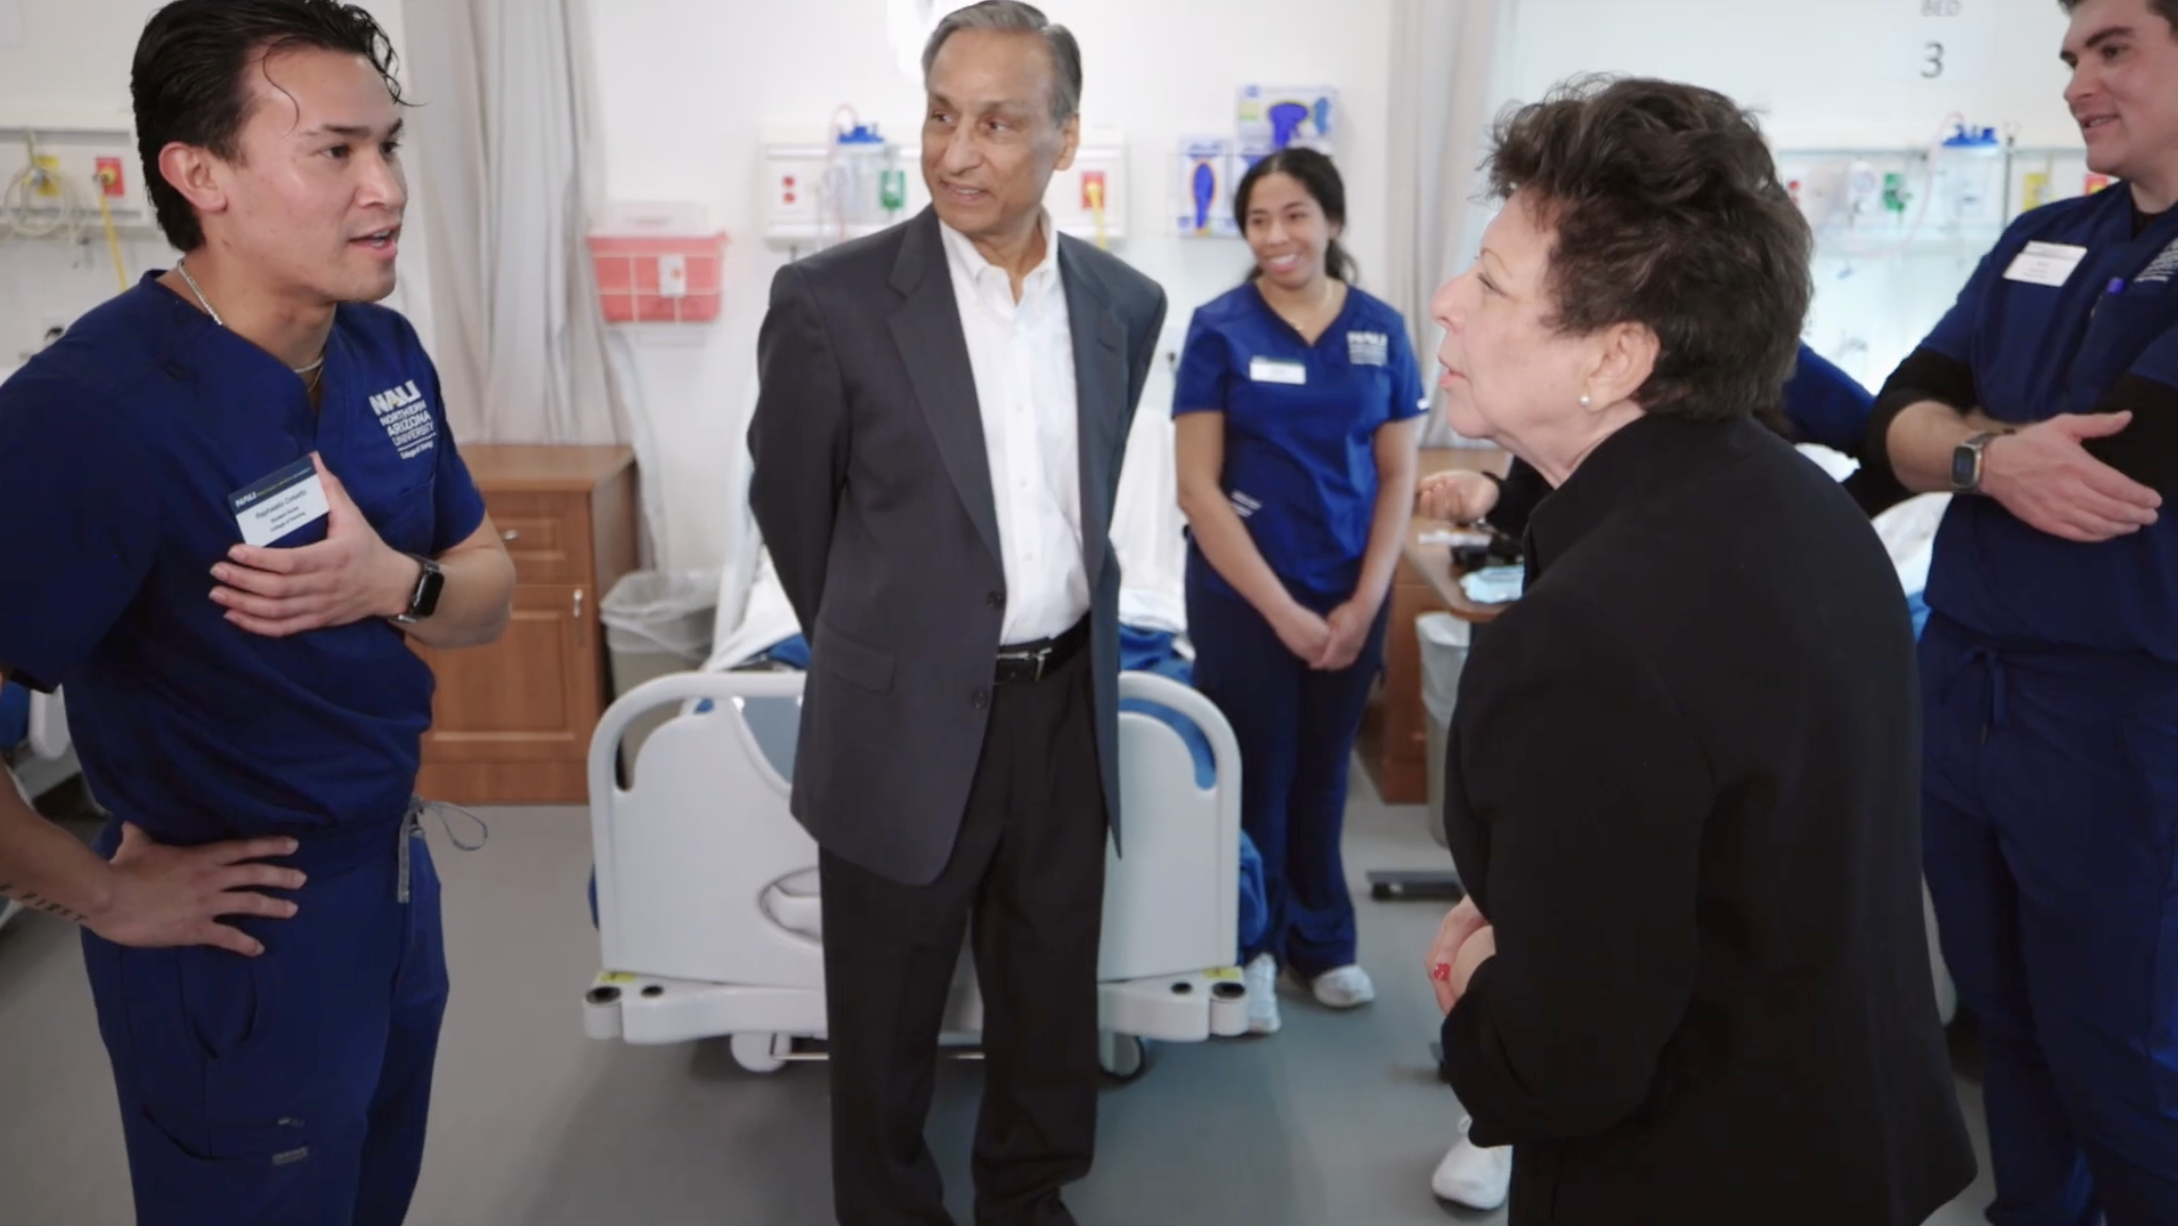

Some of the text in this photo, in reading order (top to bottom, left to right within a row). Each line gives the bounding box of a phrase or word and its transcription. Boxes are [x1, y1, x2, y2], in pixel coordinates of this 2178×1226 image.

[1920, 41, 1944, 78] 3
[368, 379, 422, 416] NAU
[379, 399, 428, 427] NORTHERN
[387, 410, 432, 437] ARIZONA
[391, 421, 434, 447] UNIVERSITY
[235, 491, 257, 507] NAU
